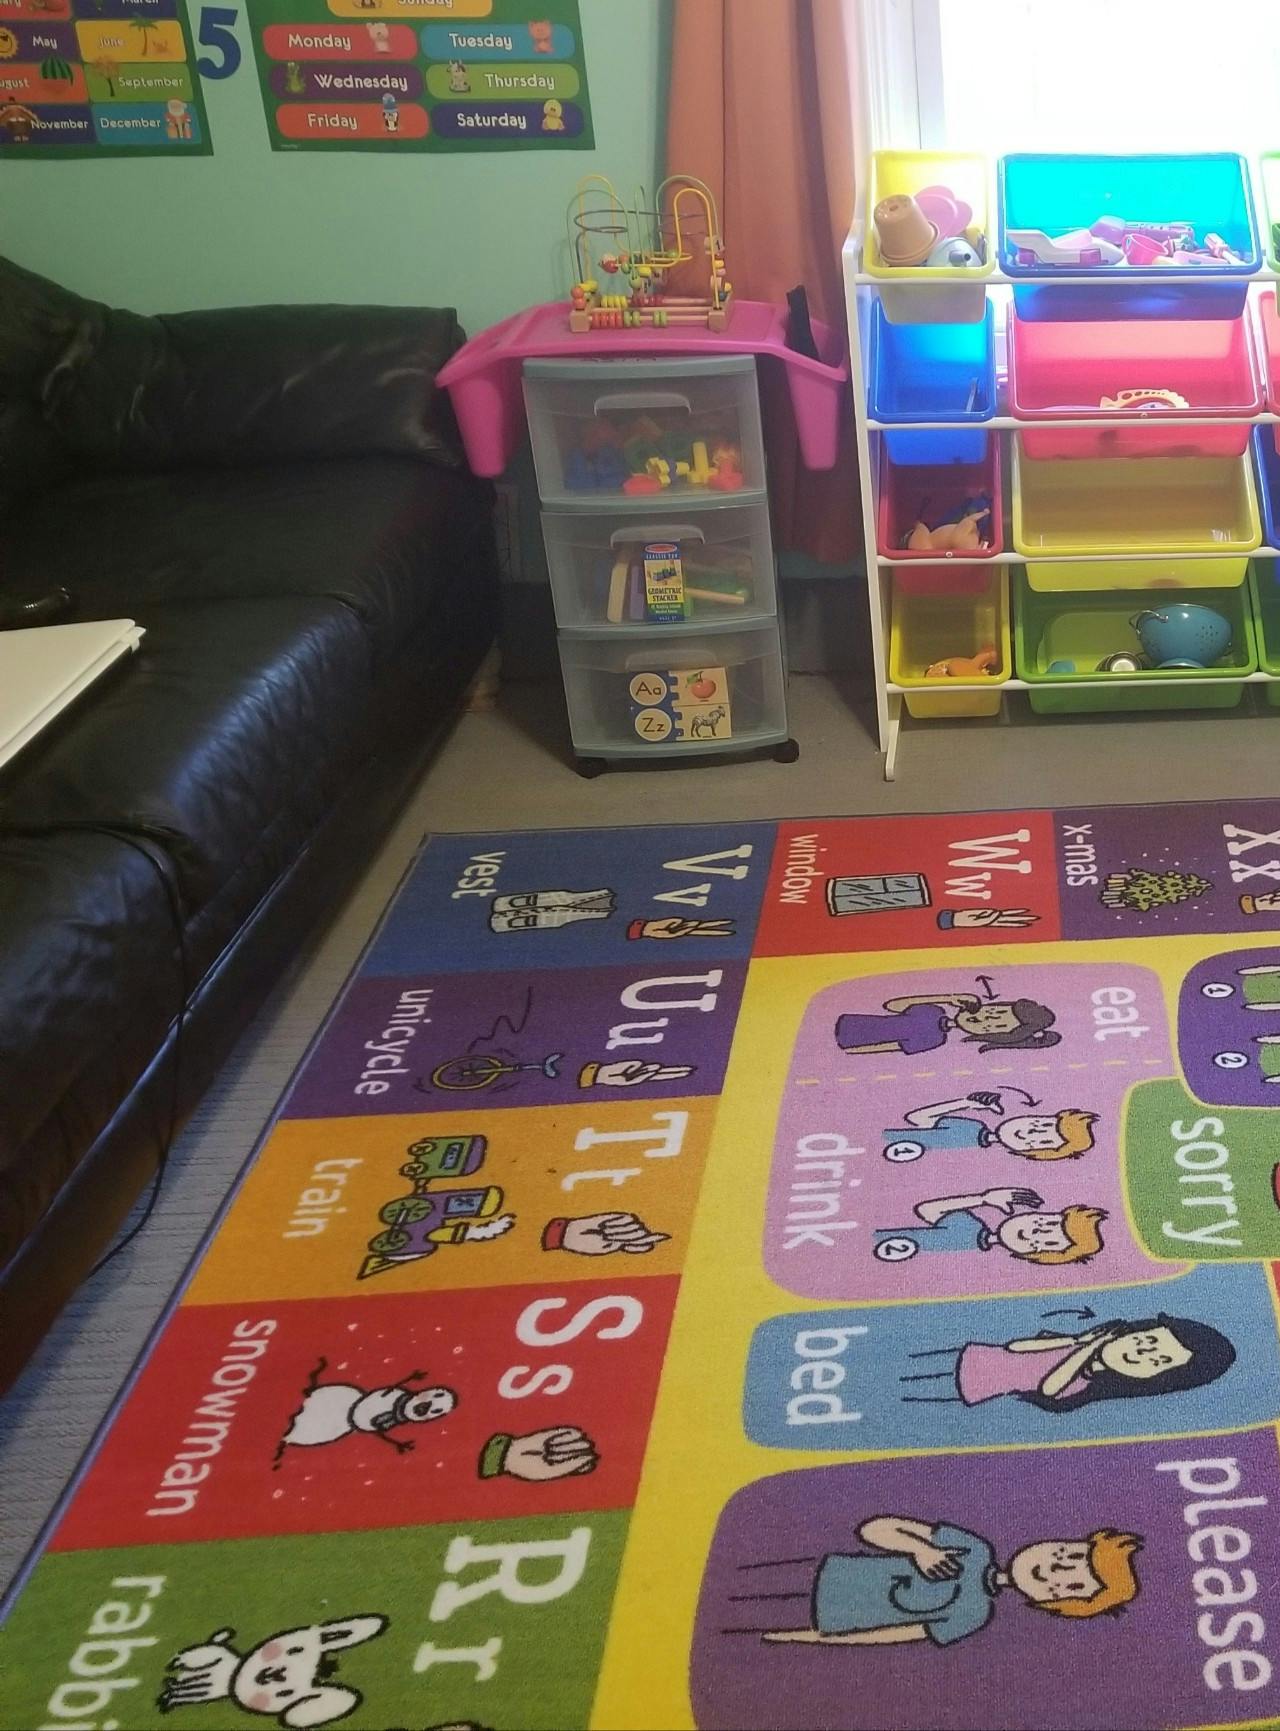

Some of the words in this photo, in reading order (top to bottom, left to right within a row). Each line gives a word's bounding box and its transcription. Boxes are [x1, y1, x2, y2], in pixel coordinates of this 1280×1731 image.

[32, 35, 58, 50] May
[197, 6, 241, 80] 5
[288, 33, 351, 51] Monday
[449, 33, 513, 51] Tuesday
[0, 76, 30, 89] ugust
[118, 76, 184, 89] September
[314, 73, 408, 91] Wednesday
[484, 73, 556, 90] Thursday
[31, 119, 89, 130] November
[100, 117, 161, 128] December
[307, 113, 358, 130] Friday
[457, 113, 527, 130] Saturday
[648, 587, 682, 595] GEOMETRIC
[635, 681, 662, 696] Aa
[642, 717, 666, 733] Zz
[451, 851, 507, 899] vest
[652, 844, 753, 907] Vv
[779, 833, 818, 905] window
[944, 828, 1032, 901] Ww
[1062, 823, 1098, 887] x-mas
[605, 969, 723, 1050] Uu
[1091, 986, 1149, 1041] eat
[1208, 985, 1229, 997] 1
[354, 989, 434, 1096] unicycle
[1221, 1054, 1242, 1067] 2
[560, 1110, 689, 1193] Tt
[890, 1143, 916, 1161] 1
[282, 1157, 364, 1240] train
[783, 1132, 865, 1250] drink
[1162, 1117, 1243, 1248] sorry
[882, 1239, 909, 1259] 2
[498, 1294, 644, 1400] Ss
[786, 1326, 868, 1426] bed
[145, 1318, 277, 1518] snowman
[1155, 1457, 1273, 1692] please
[414, 1527, 592, 1682] Rr
[37, 1575, 167, 1731] rabbi
